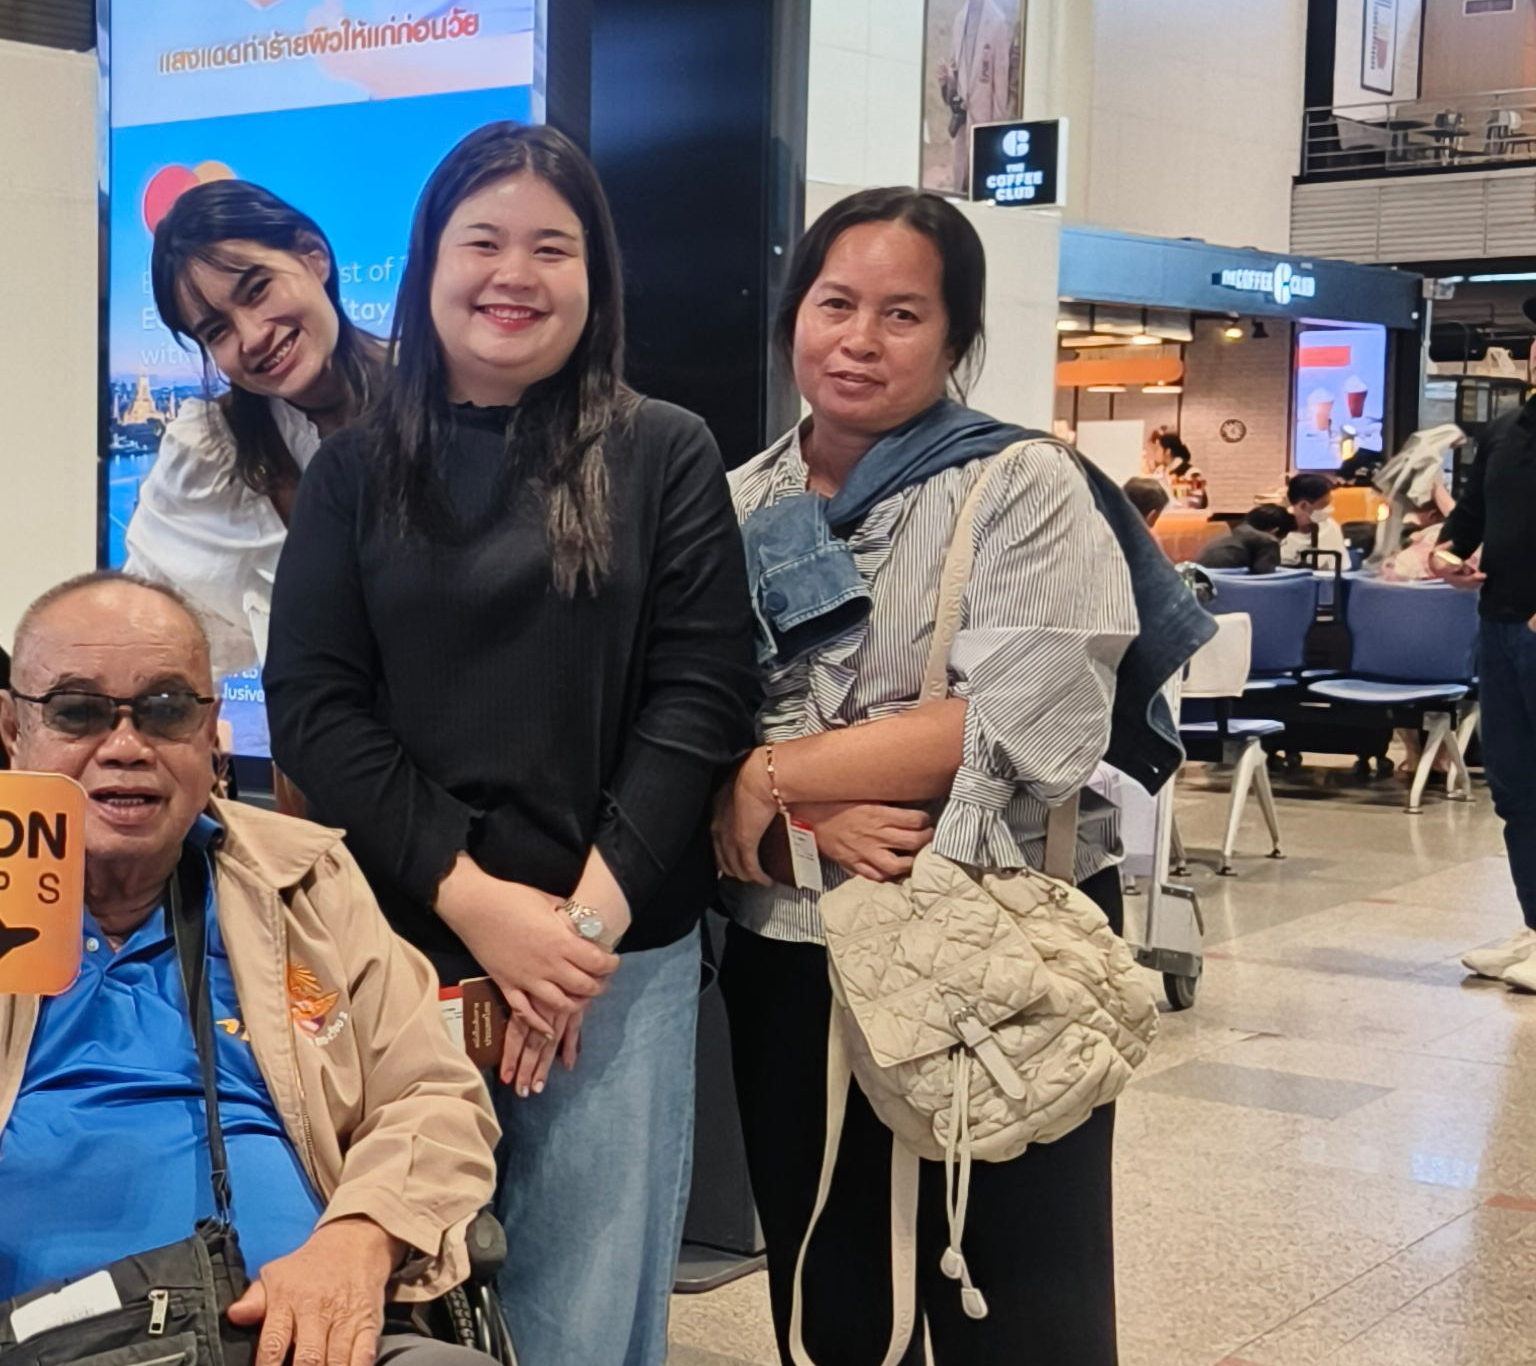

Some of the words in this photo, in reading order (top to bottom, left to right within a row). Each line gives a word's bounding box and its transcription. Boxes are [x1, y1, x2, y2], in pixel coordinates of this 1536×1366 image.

[159, 7, 480, 74] แสงแดดทำร้ายผิวให้แก่ก่อนวัย
[986, 170, 1043, 189] COFFEE
[995, 185, 1035, 202] CLUB
[369, 256, 395, 283] of
[340, 297, 391, 326] tay
[222, 682, 265, 703] lusive
